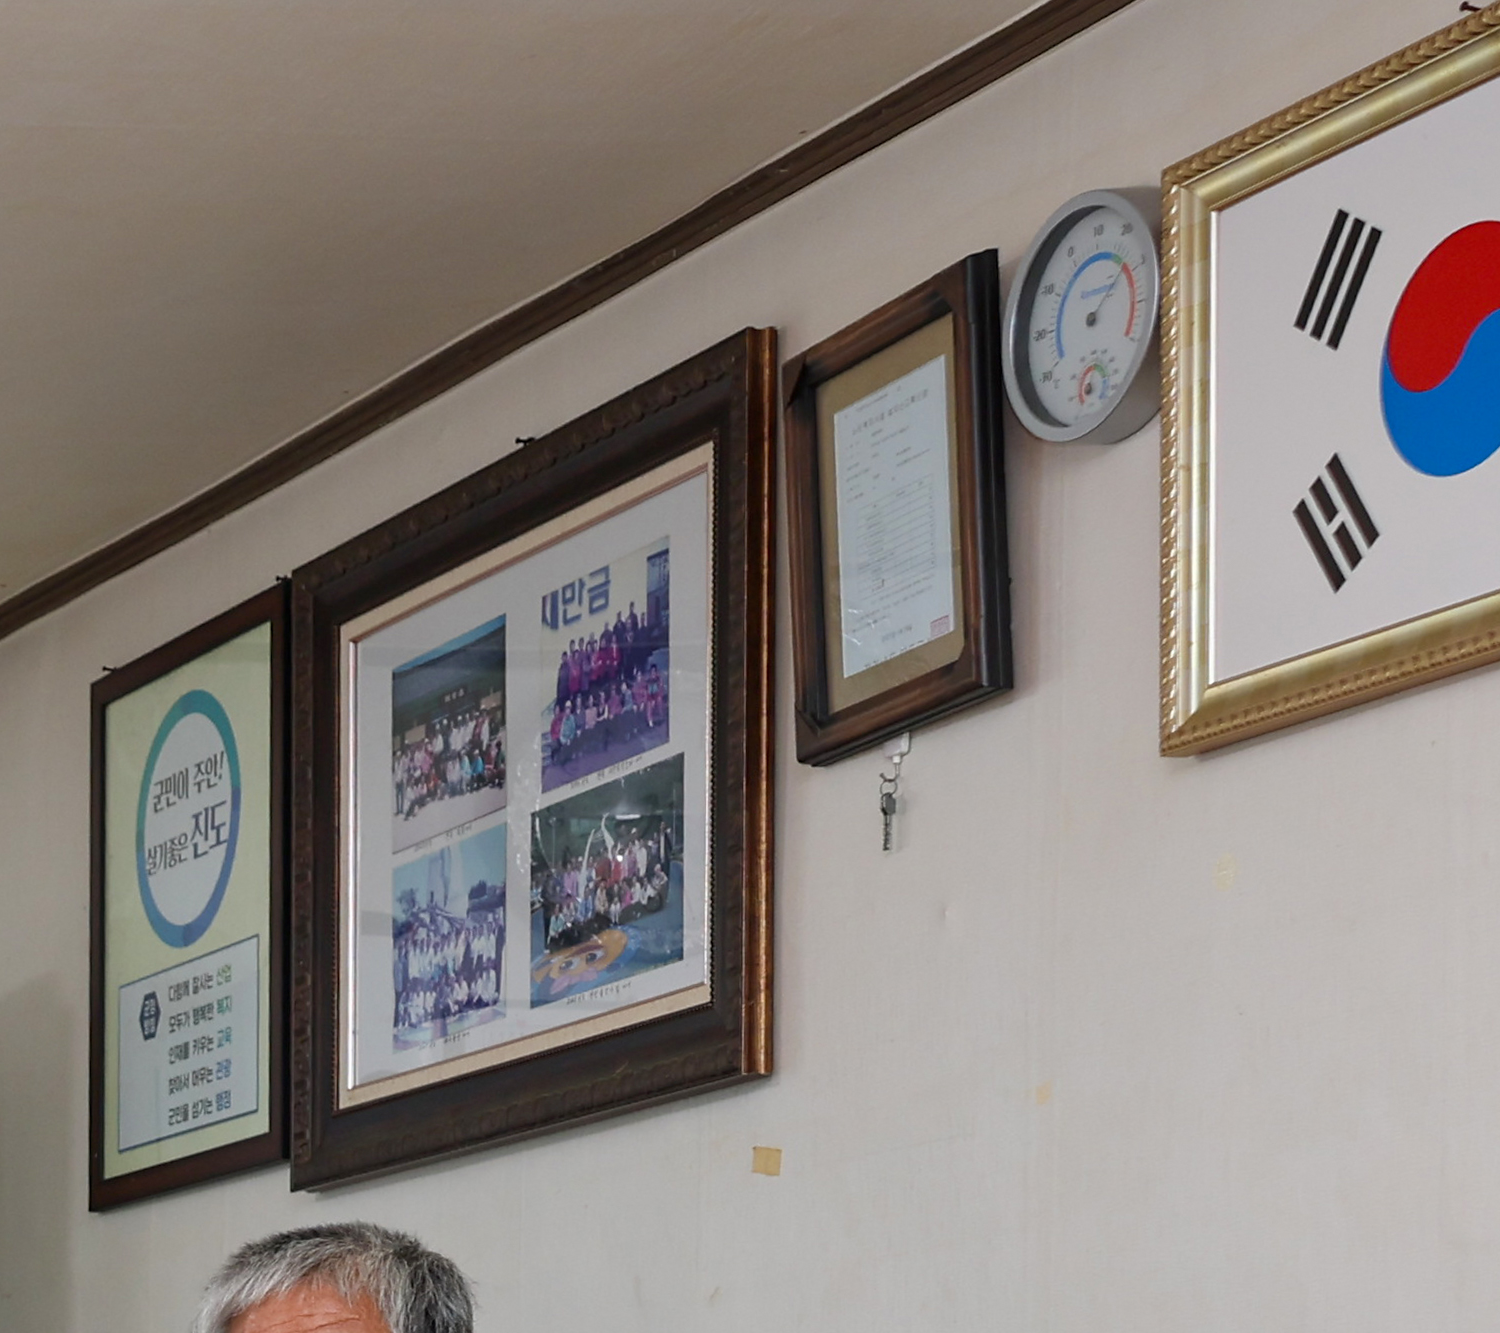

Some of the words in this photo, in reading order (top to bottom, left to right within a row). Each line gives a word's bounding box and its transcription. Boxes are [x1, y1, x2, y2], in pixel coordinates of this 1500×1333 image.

[153, 767, 189, 813] 군민이
[194, 751, 224, 793] 주인!
[146, 833, 188, 876] 살기좋은
[190, 800, 228, 859] 진도
[169, 1010, 190, 1033] 모두가
[192, 1035, 214, 1056] 키우는
[168, 1072, 190, 1096] 찾아서
[168, 1103, 189, 1126] 군민을
